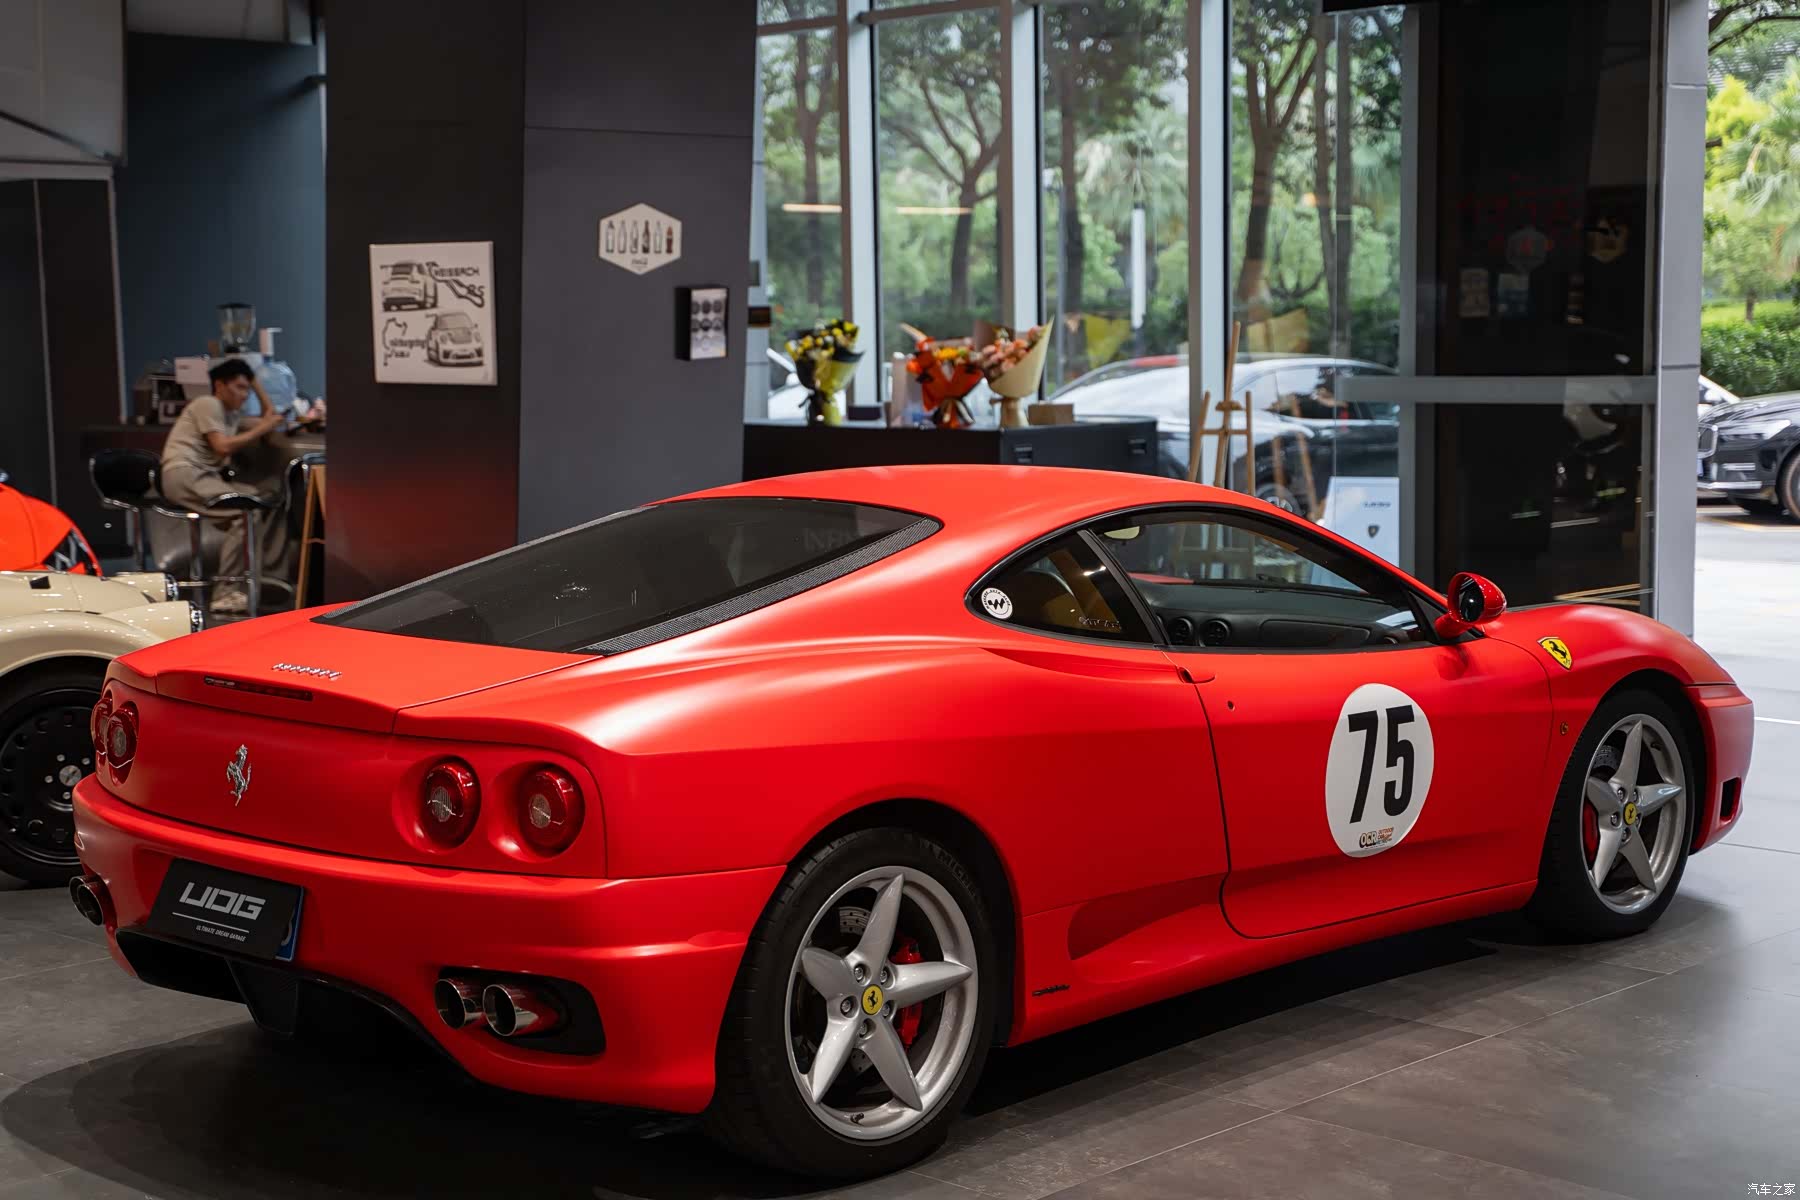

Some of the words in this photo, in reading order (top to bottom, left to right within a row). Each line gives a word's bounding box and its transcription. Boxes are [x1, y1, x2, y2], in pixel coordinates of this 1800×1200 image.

[1348, 705, 1415, 824] 75
[179, 882, 266, 920] UDG
[196, 925, 216, 934] ULTIMATE
[215, 929, 230, 938] DREAM
[229, 933, 246, 942] GARAGE
